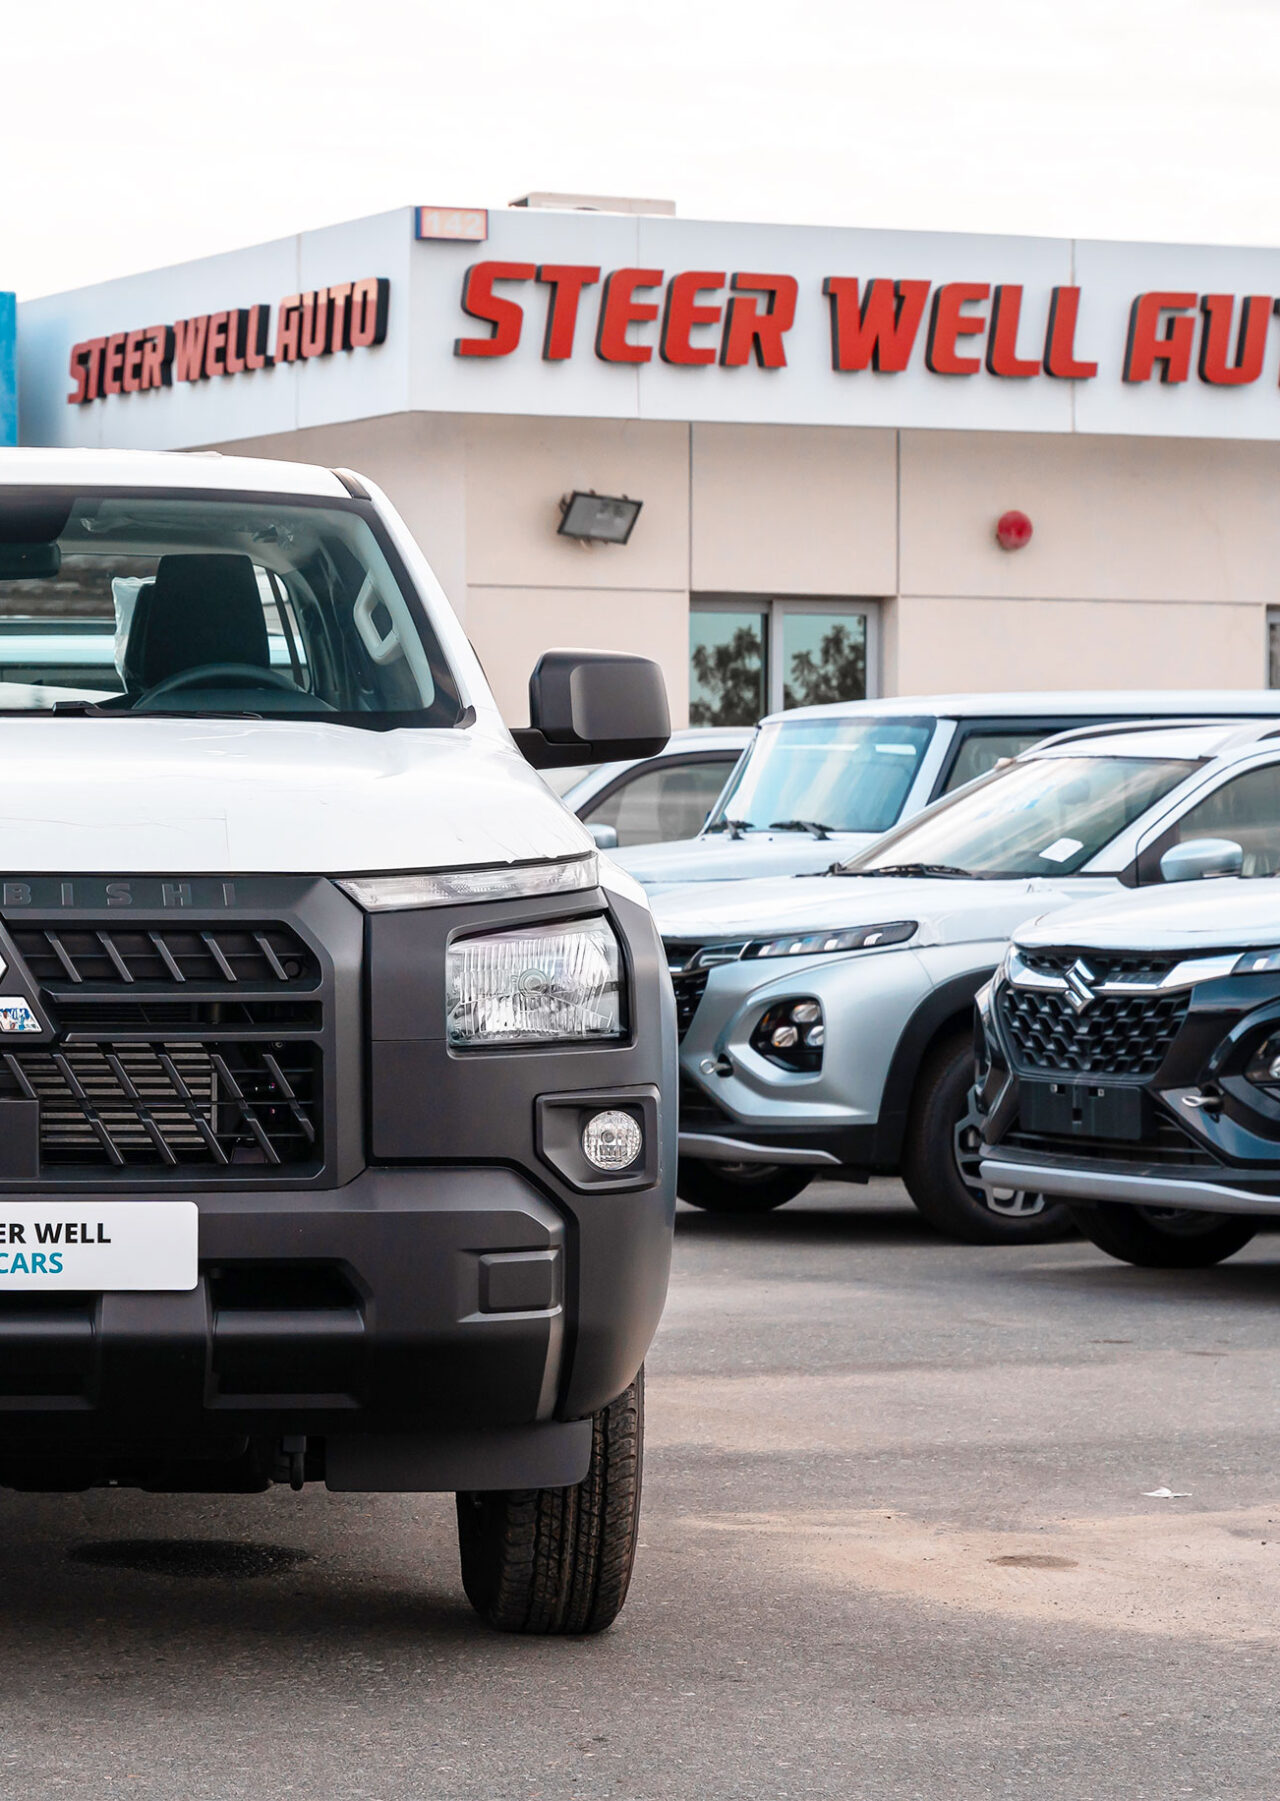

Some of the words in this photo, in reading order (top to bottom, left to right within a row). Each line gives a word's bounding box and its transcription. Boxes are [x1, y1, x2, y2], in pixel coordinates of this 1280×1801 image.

[67, 325, 174, 404] STEER
[173, 304, 274, 383] WELL
[274, 277, 390, 364] AUTO
[454, 260, 798, 369] STEER
[822, 276, 1099, 380] WELL
[1122, 291, 1280, 386] AU
[35, 1223, 111, 1244] WELL
